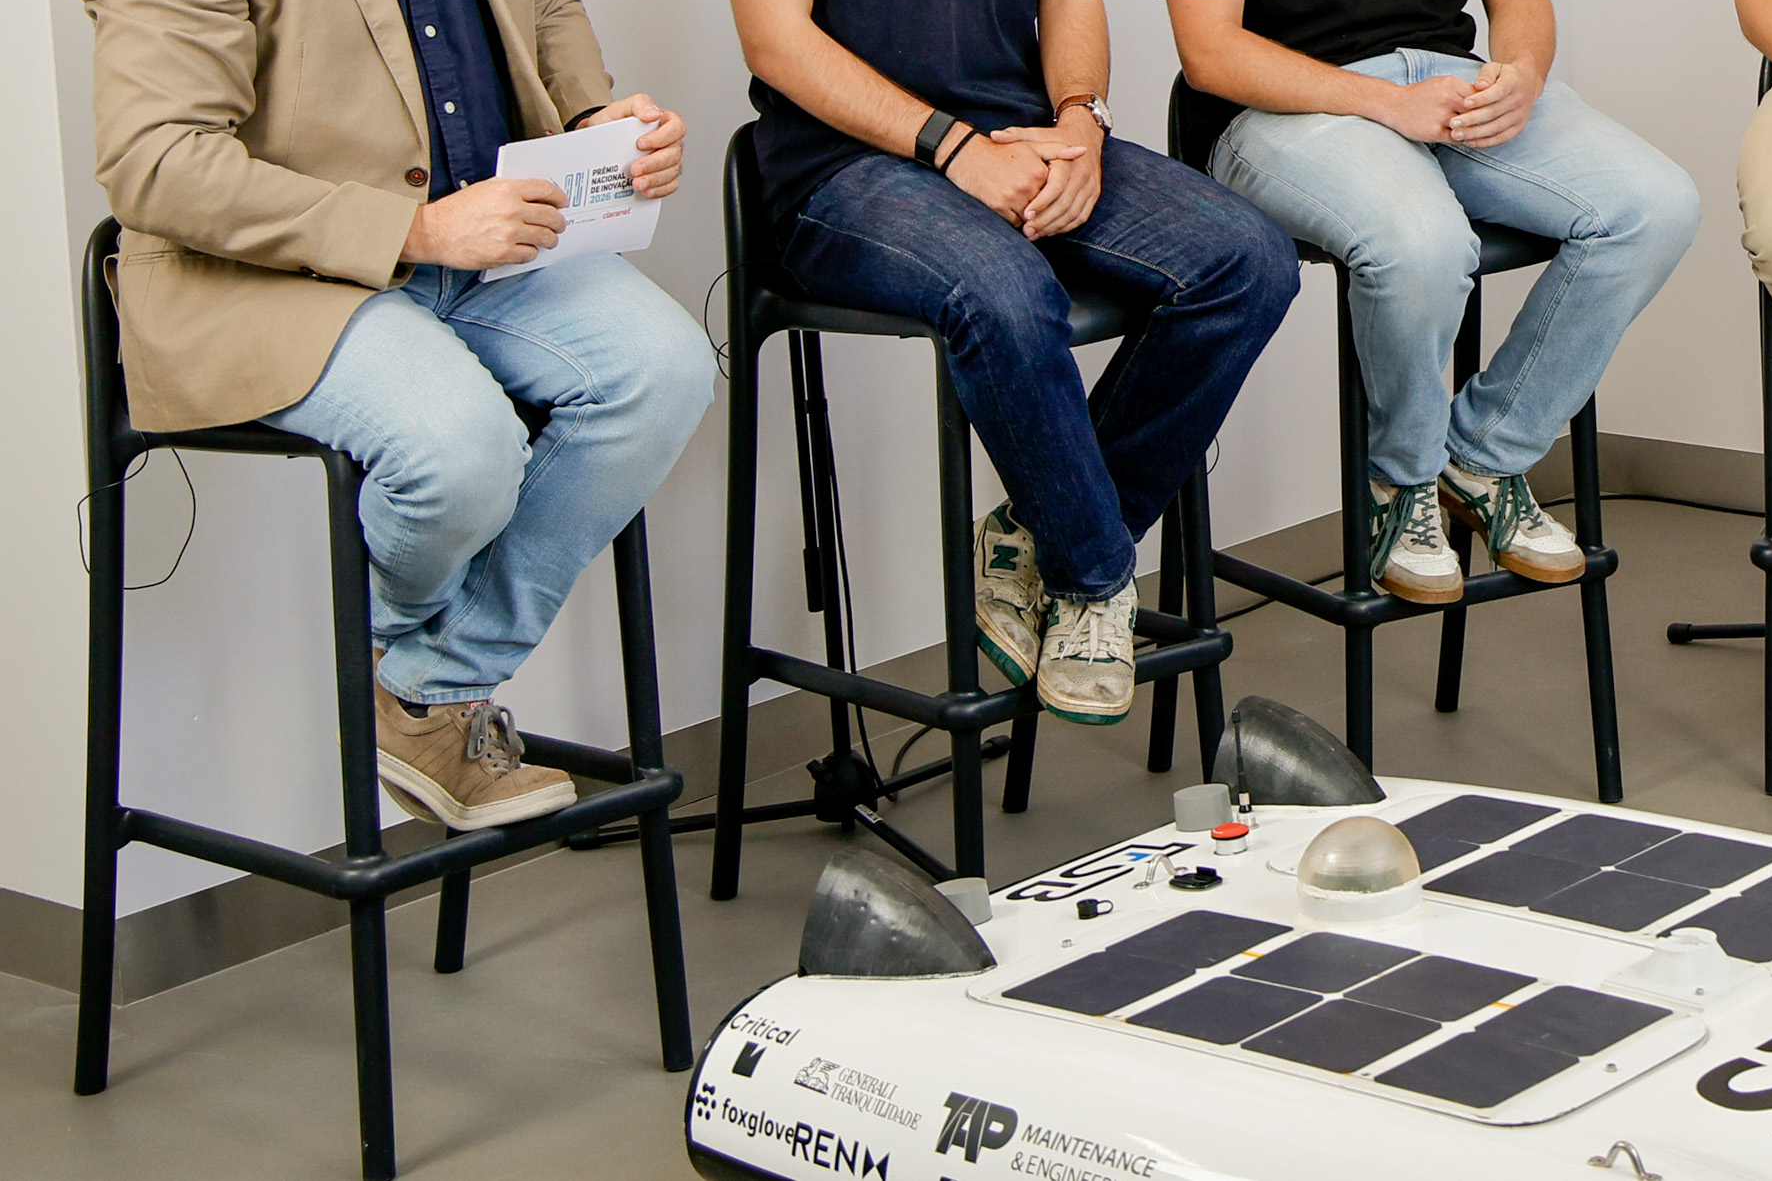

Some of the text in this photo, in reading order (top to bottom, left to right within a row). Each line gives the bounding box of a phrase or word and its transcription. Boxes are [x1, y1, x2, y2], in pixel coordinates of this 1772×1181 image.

[591, 172, 626, 185] NACIONAL
[592, 165, 618, 176] PRÉMIO
[589, 192, 612, 204] 2026
[590, 185, 600, 194] DE
[602, 207, 631, 219] claranet
[728, 1012, 801, 1048] Critical
[837, 1066, 898, 1101] GENERALI
[721, 1098, 795, 1146] foxglove
[830, 1083, 922, 1131] TRANQUILIDADE
[935, 1091, 1019, 1164] TAP
[791, 1121, 860, 1173] REN
[1010, 1151, 1024, 1173] &
[1021, 1123, 1158, 1179] MAINTENANCE
